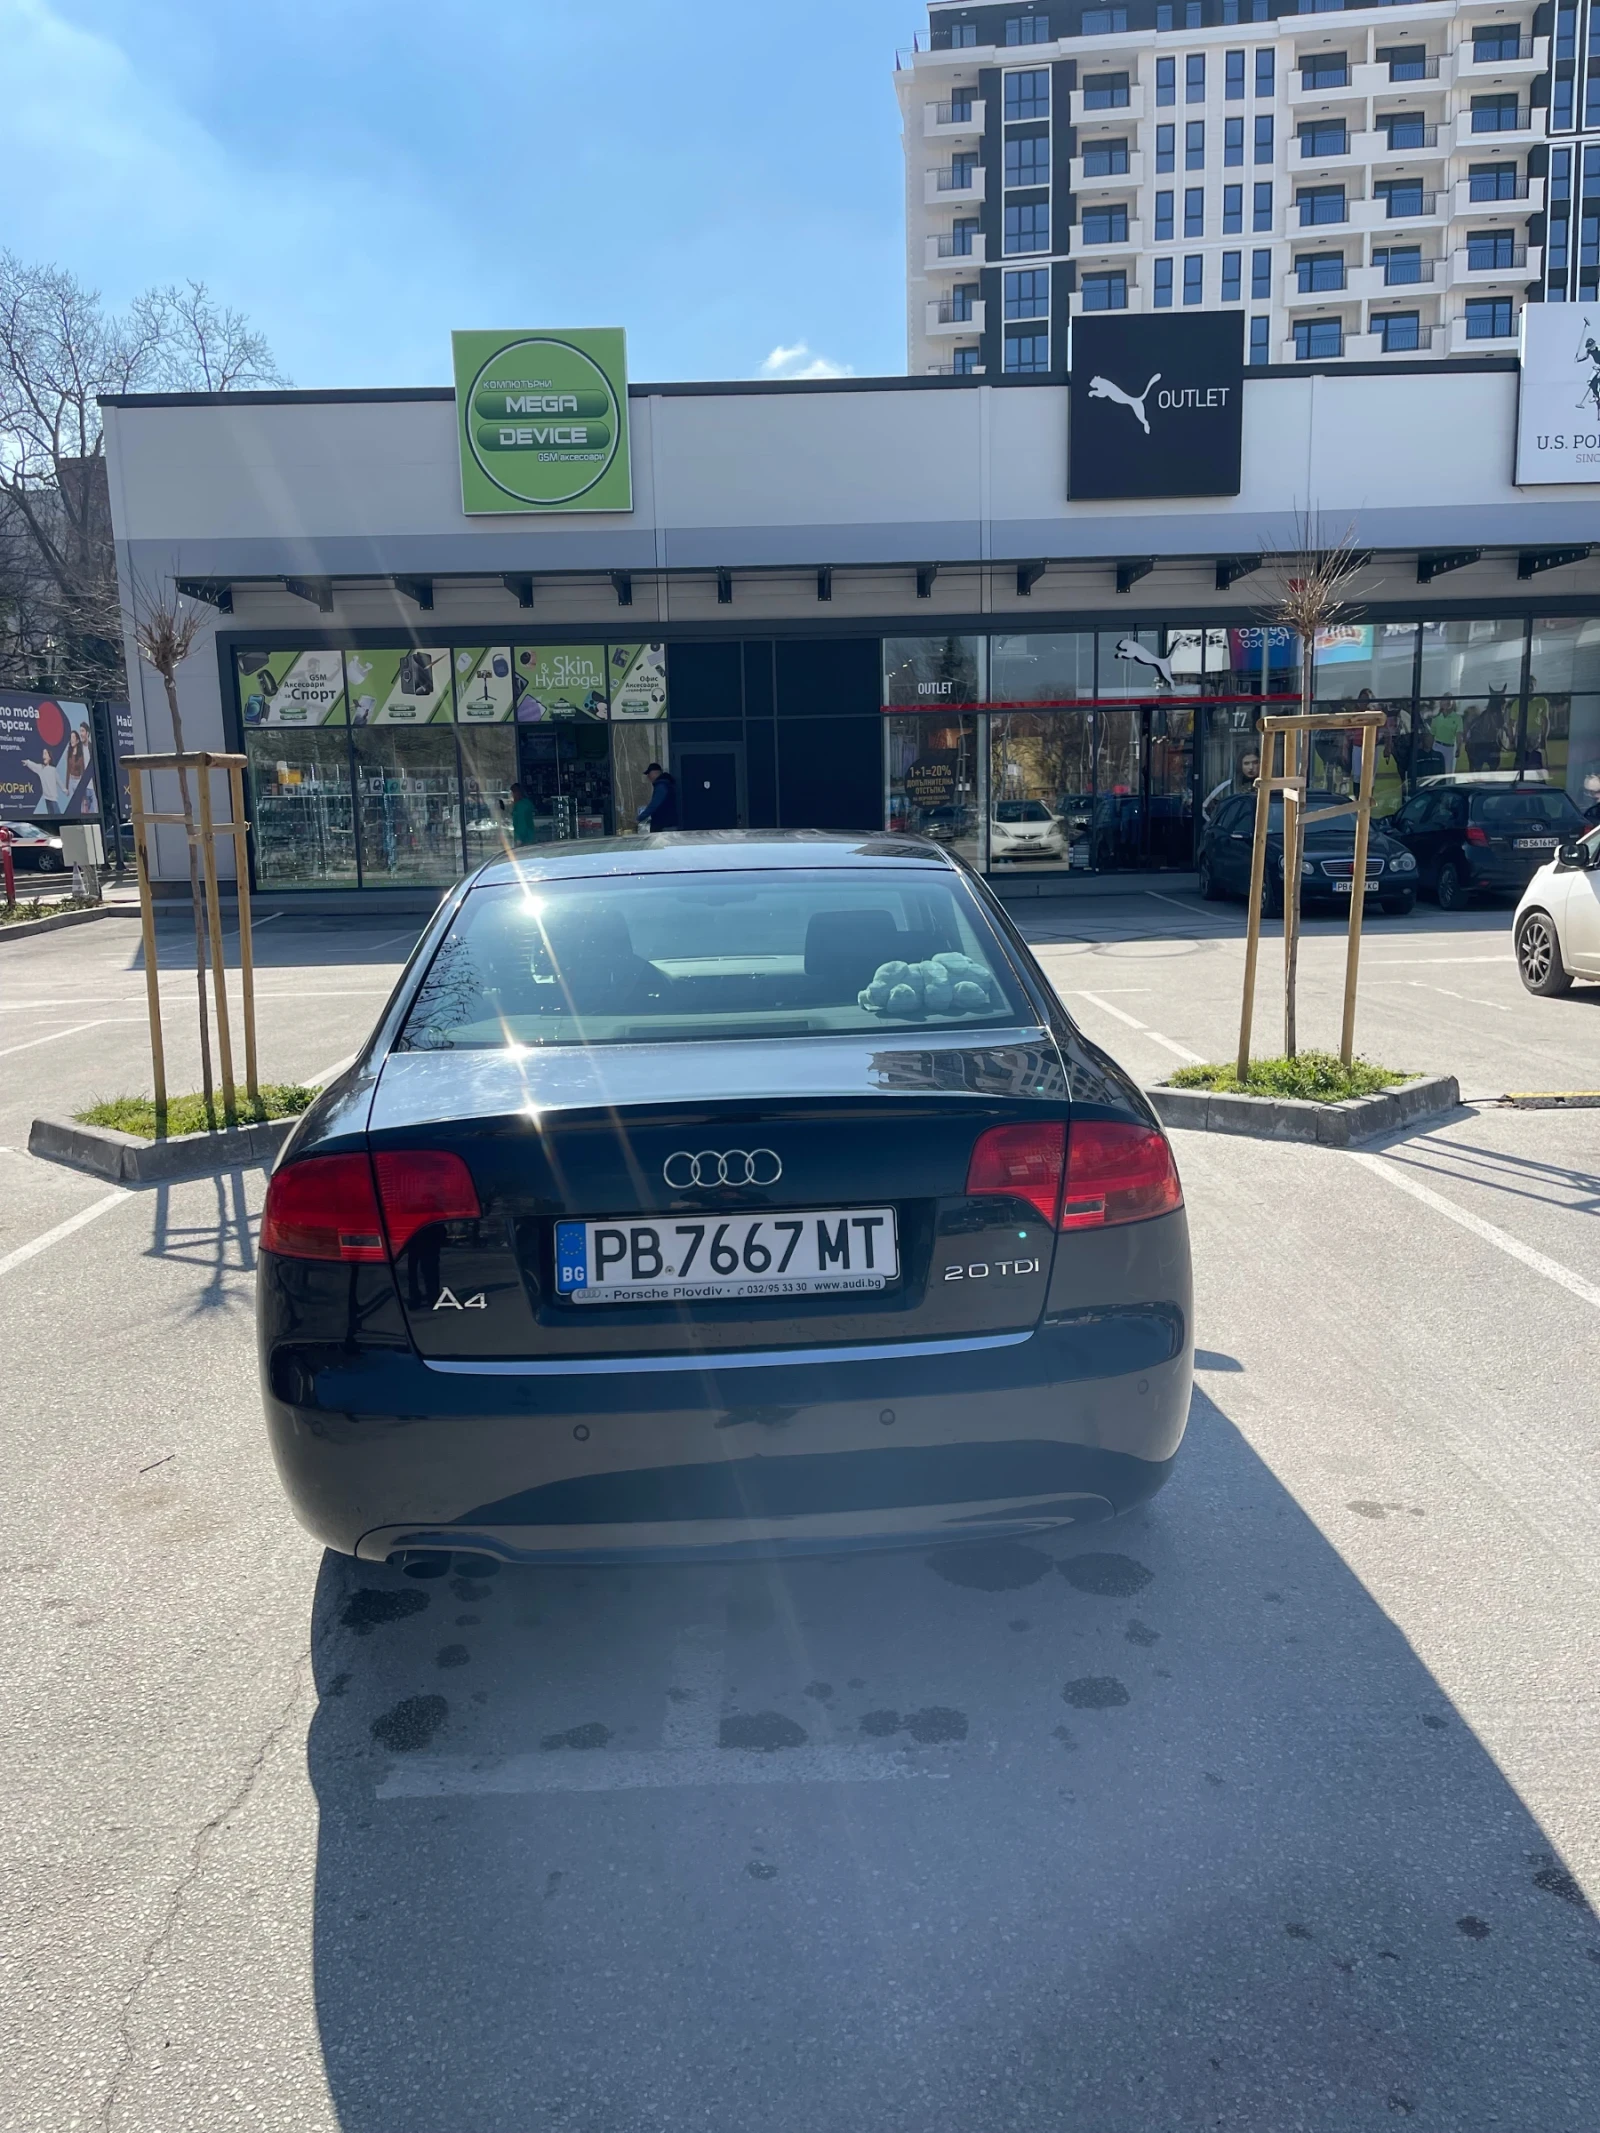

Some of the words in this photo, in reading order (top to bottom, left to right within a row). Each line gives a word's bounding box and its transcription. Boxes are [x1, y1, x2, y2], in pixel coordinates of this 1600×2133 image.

[506, 395, 578, 413] MEGA
[1158, 388, 1230, 409] OUTLET
[499, 427, 588, 445] DEVICE
[1537, 435, 1568, 450] U.S.
[538, 453, 558, 462] GSM
[541, 662, 549, 674] &
[553, 656, 594, 675] Skin
[536, 672, 602, 690] Hydrogel
[918, 682, 952, 695] OUTLET
[291, 688, 336, 702] Спорт
[910, 764, 952, 778] 1+1=20%
[562, 1266, 585, 1282] BG
[432, 1286, 488, 1310] A4
[613, 1287, 669, 1300] Porsche
[673, 1286, 722, 1298] Plovdiv
[746, 1283, 780, 1295] 032/95
[782, 1282, 793, 1292] 33
[796, 1282, 807, 1292] 30
[814, 1278, 881, 1292] www.audi.bg
